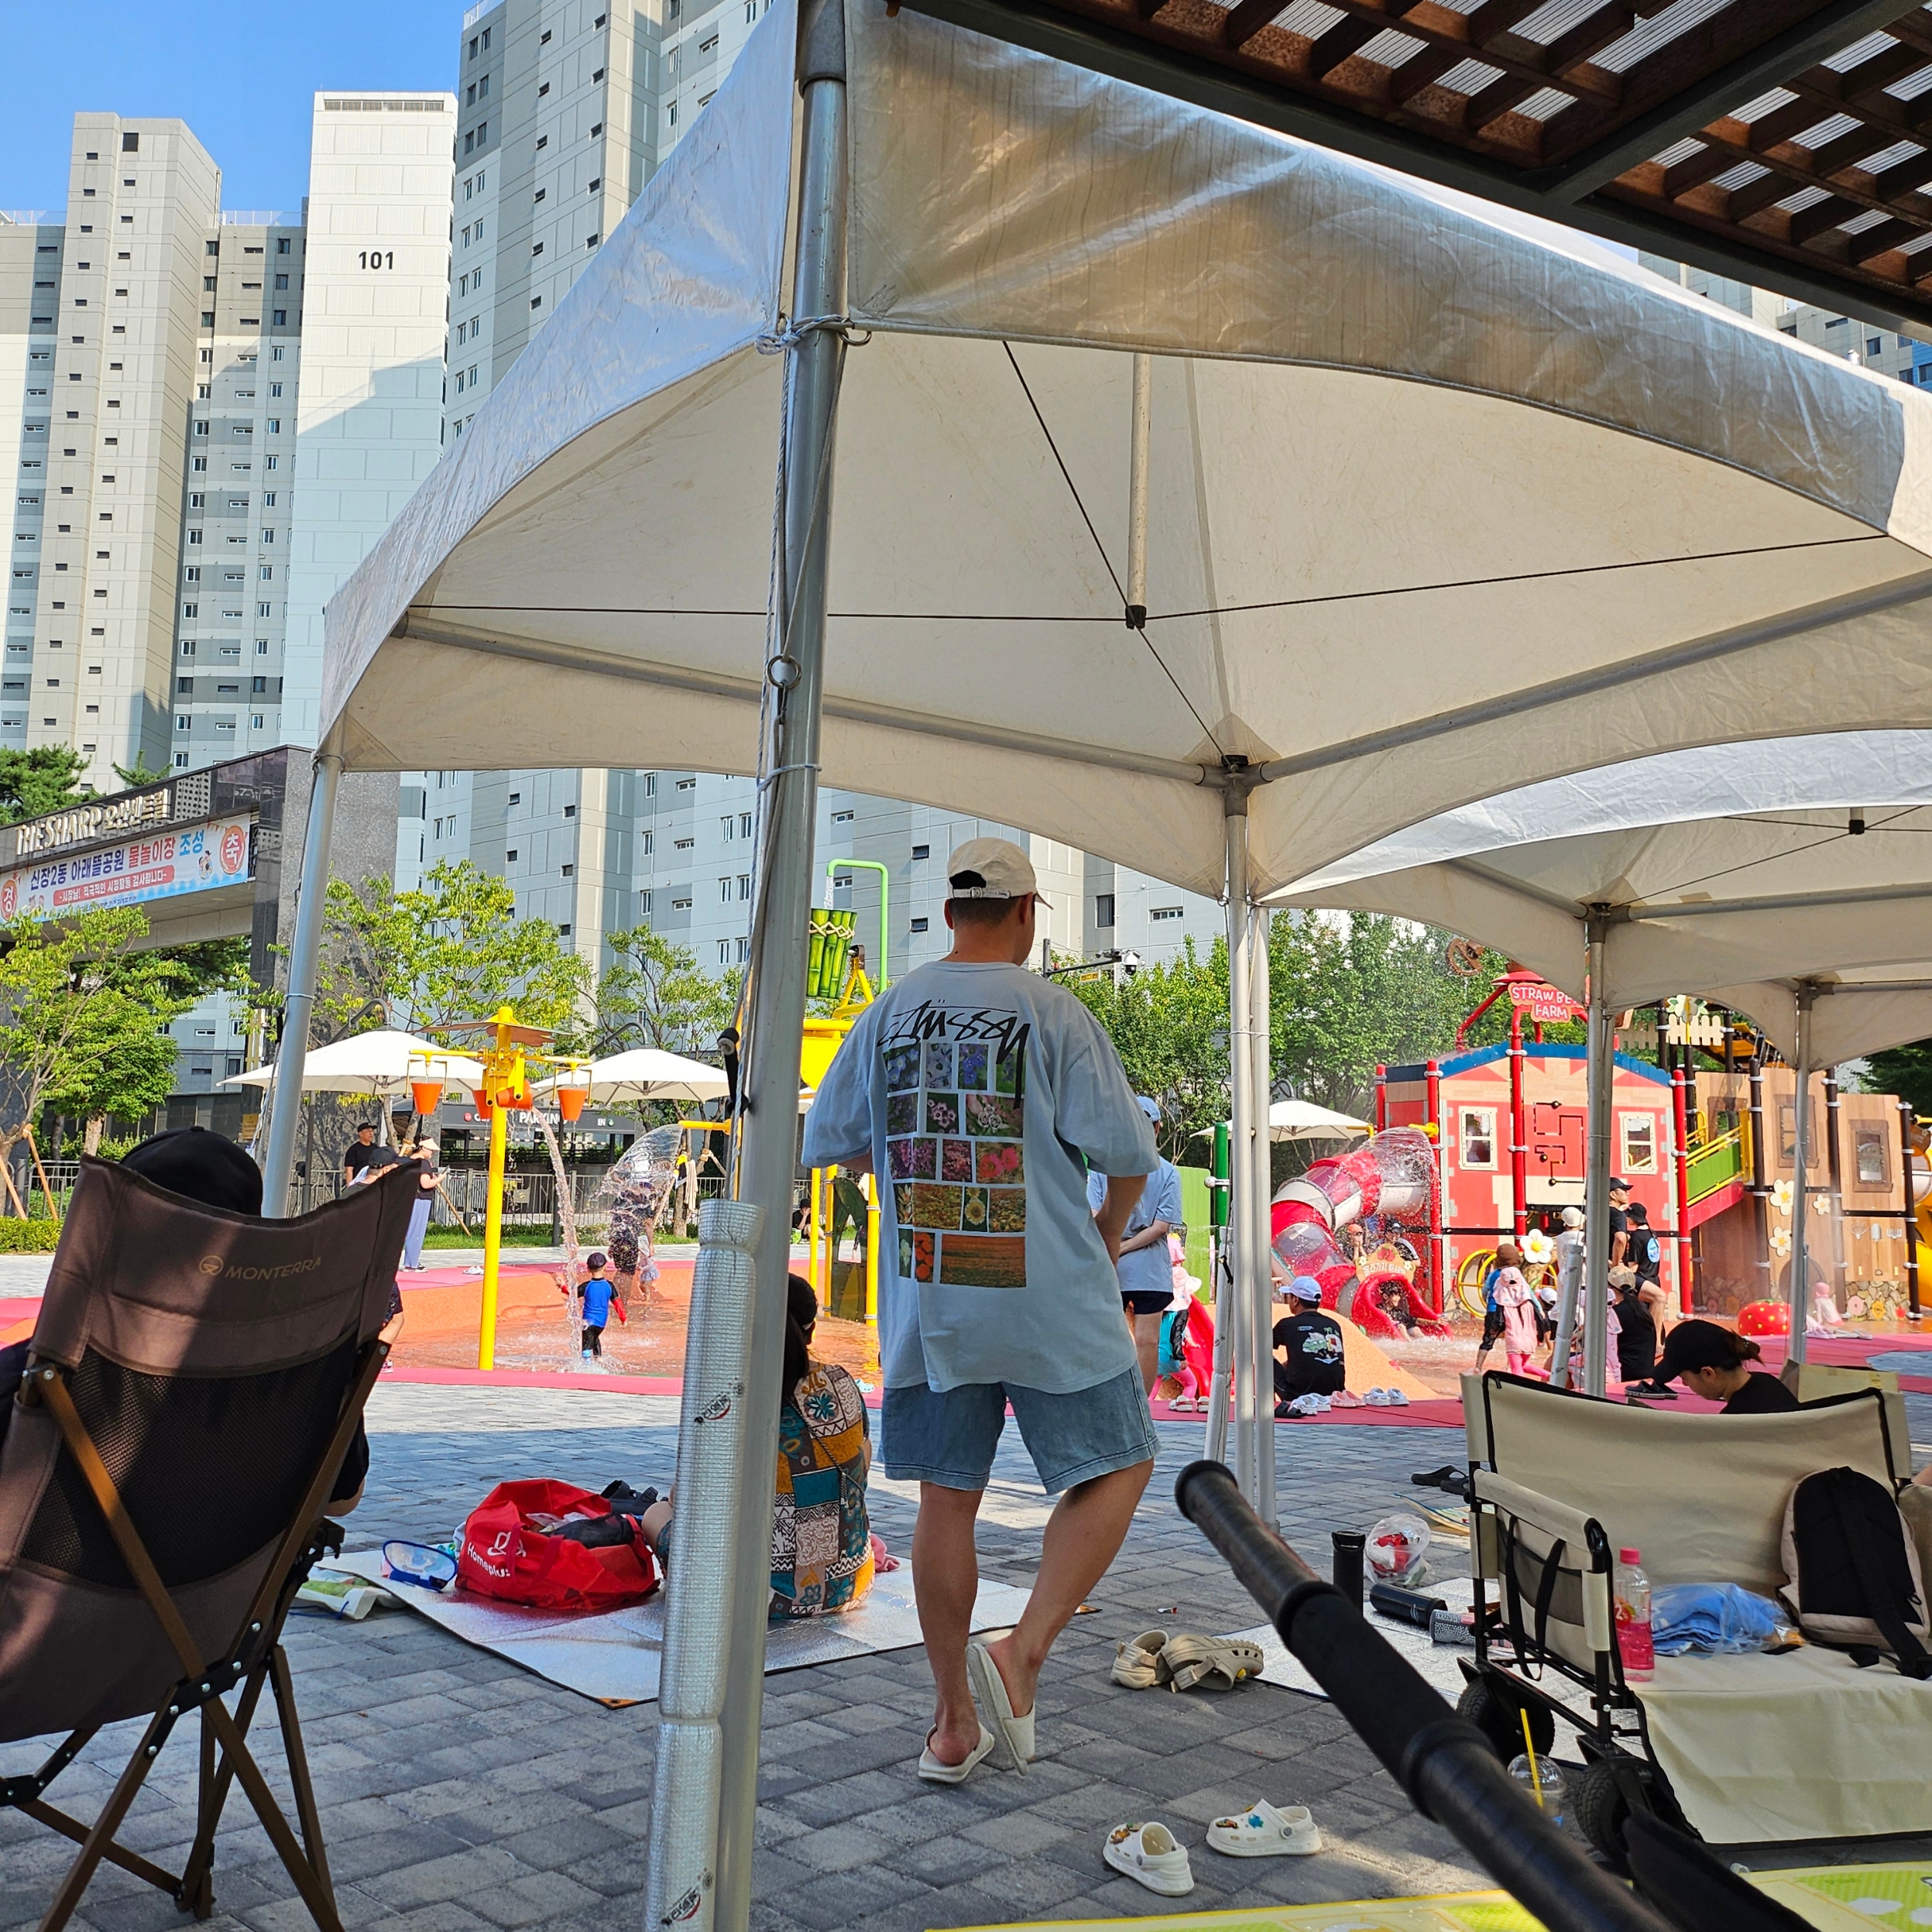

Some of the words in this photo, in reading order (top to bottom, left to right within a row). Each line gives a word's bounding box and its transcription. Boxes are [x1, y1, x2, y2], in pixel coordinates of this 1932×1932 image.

[359, 252, 393, 269] 101
[15, 823, 45, 856] THE
[44, 808, 102, 848] SHARP
[104, 788, 169, 829] 오산센트럴
[31, 863, 67, 891] 신장2동
[71, 848, 125, 880] 아래뜰공원
[129, 836, 176, 869] 물놀이장
[179, 829, 204, 856] 조성
[225, 833, 240, 865] 축
[4, 886, 14, 913] 경
[84, 882, 106, 897] 적극적인
[1535, 1004, 1567, 1019] FARM
[597, 1118, 606, 1127] IN
[225, 1256, 321, 1280] MONTERRA
